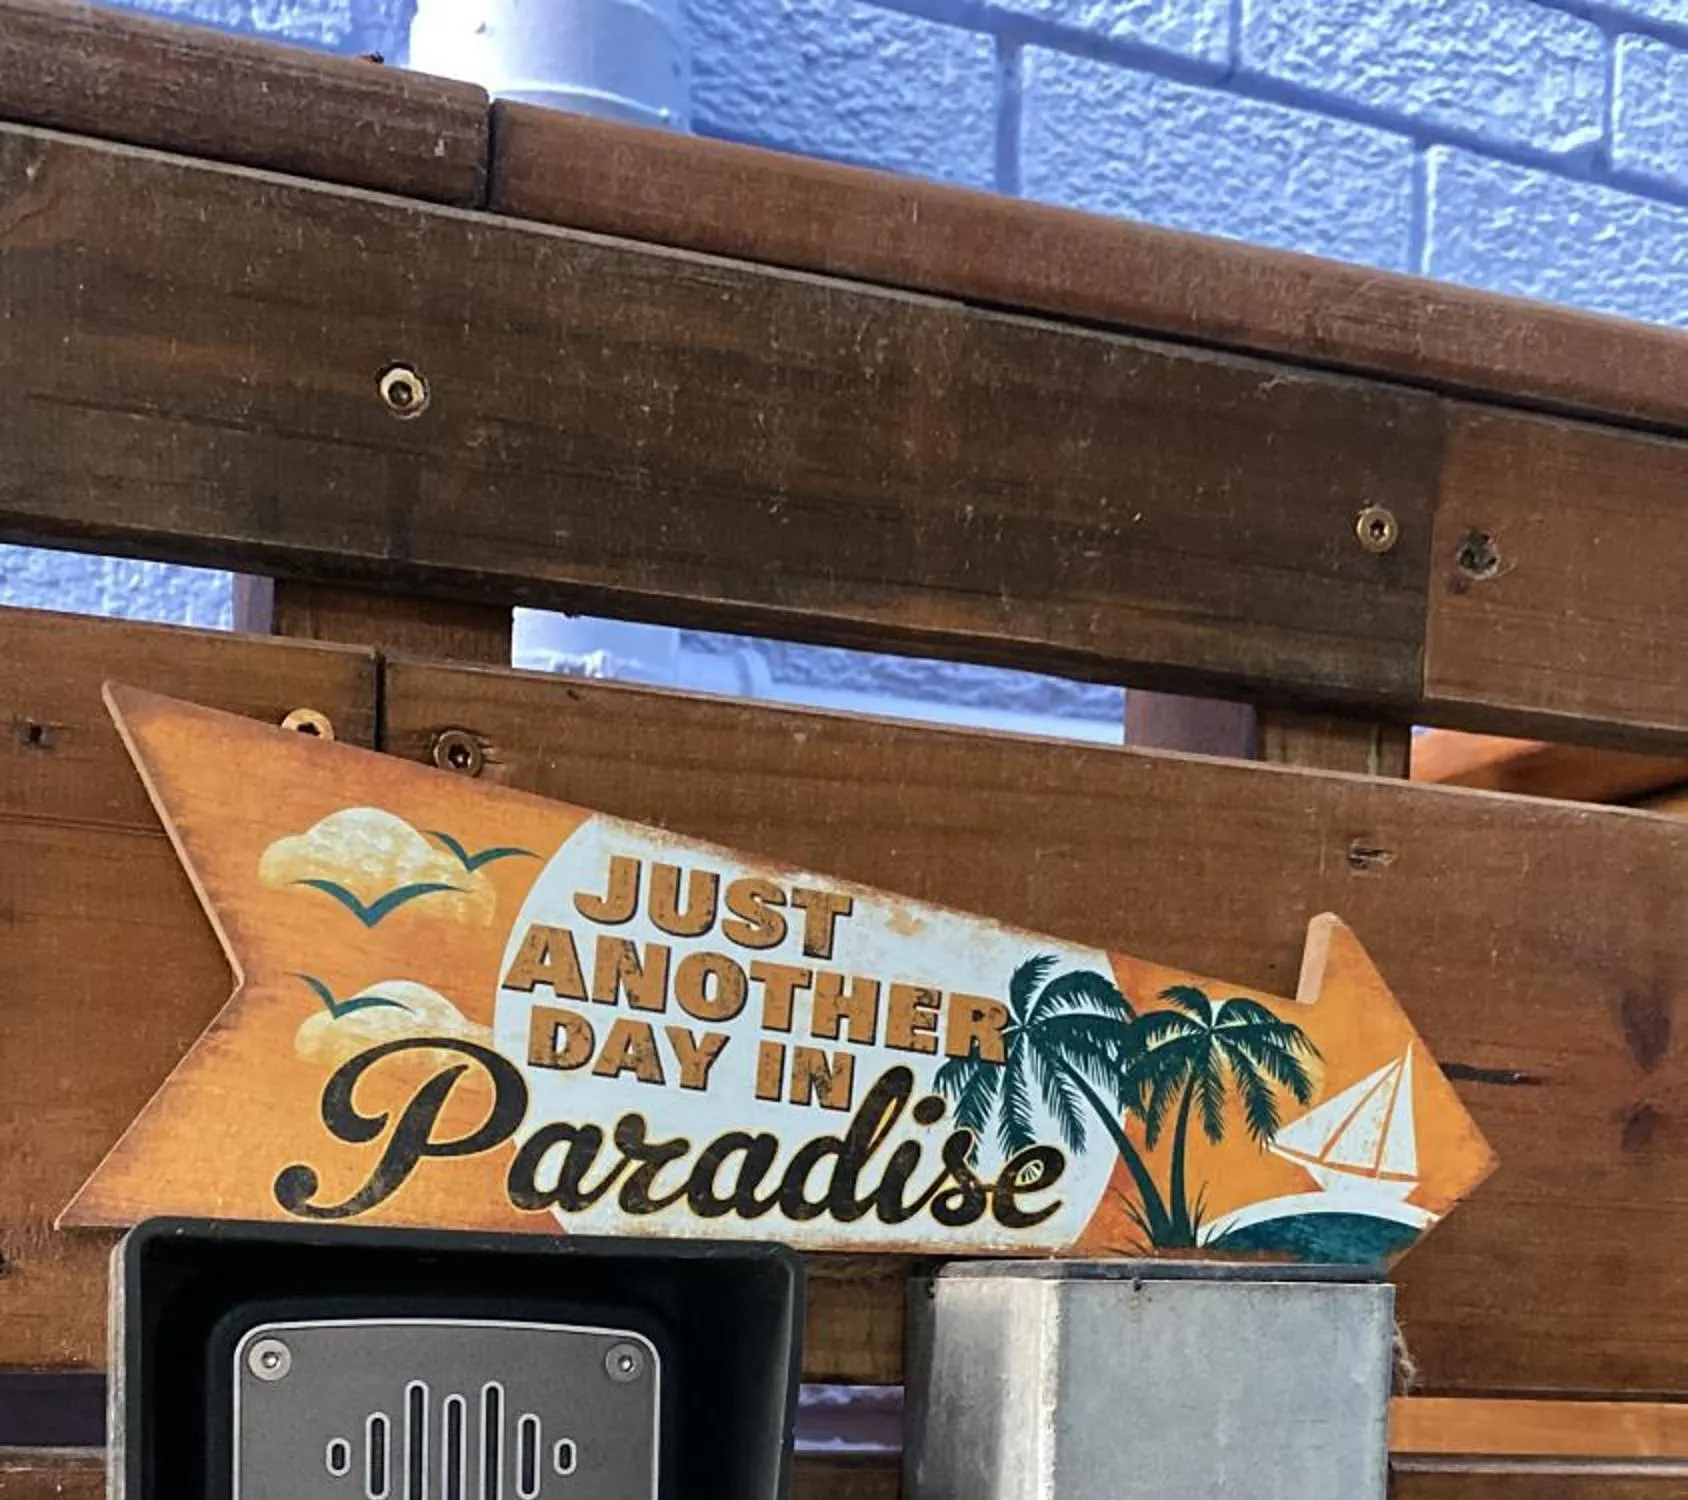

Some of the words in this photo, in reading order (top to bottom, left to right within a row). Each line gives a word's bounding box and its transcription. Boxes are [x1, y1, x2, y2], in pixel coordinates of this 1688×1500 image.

[573, 855, 853, 960] JUST
[502, 922, 1012, 1066] ANOTHER
[527, 1004, 731, 1092] DAY
[755, 1039, 857, 1113] IN
[274, 1036, 1067, 1231] Paradise
